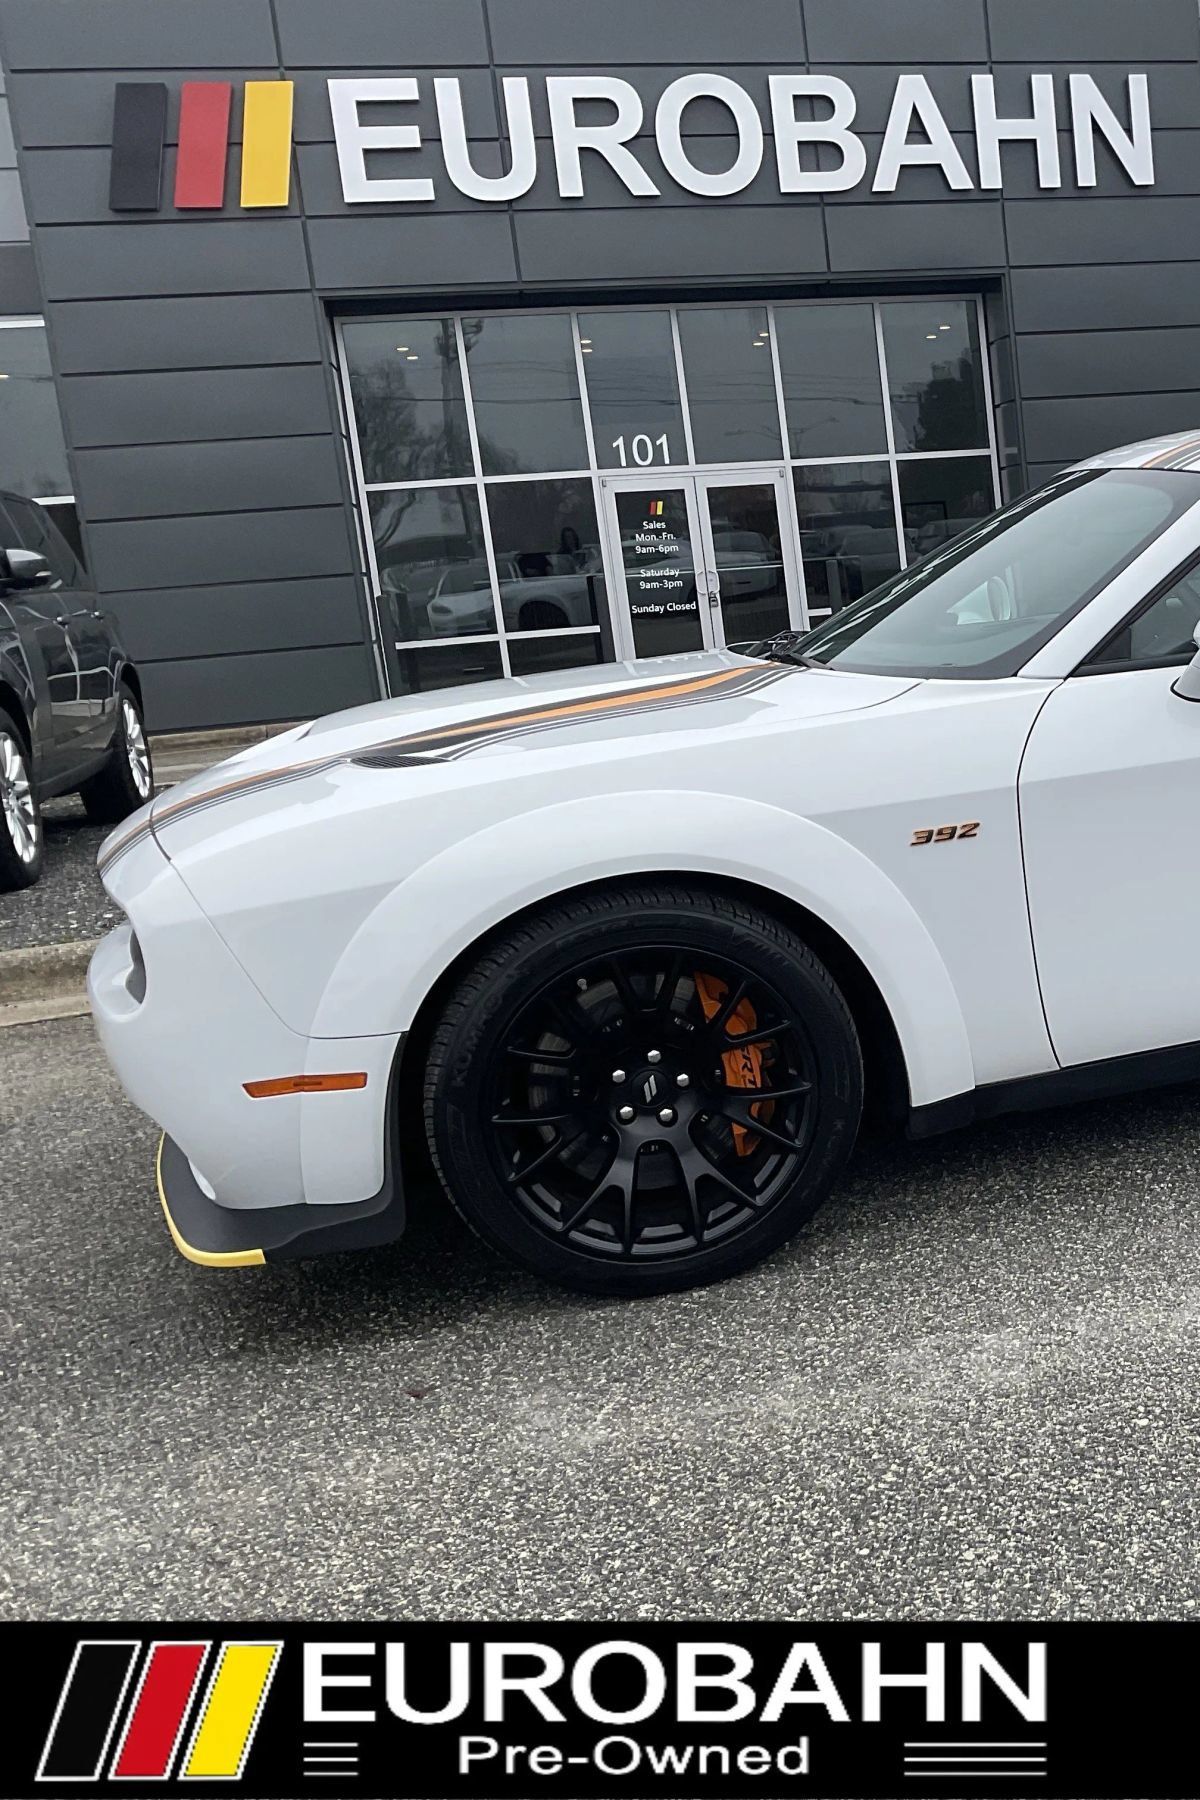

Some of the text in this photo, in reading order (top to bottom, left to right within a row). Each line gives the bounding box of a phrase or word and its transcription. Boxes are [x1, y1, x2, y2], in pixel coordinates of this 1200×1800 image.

[327, 73, 1155, 203] EUROBAHN
[612, 433, 671, 467] 101
[642, 520, 666, 530] Sales
[635, 532, 677, 542] Mon.-Fri.
[635, 544, 679, 554] 9am-6pm
[640, 567, 680, 578] Saturday
[639, 579, 683, 589] 9am-3pm
[631, 601, 697, 614] Sunday Closed
[909, 822, 981, 846] 392
